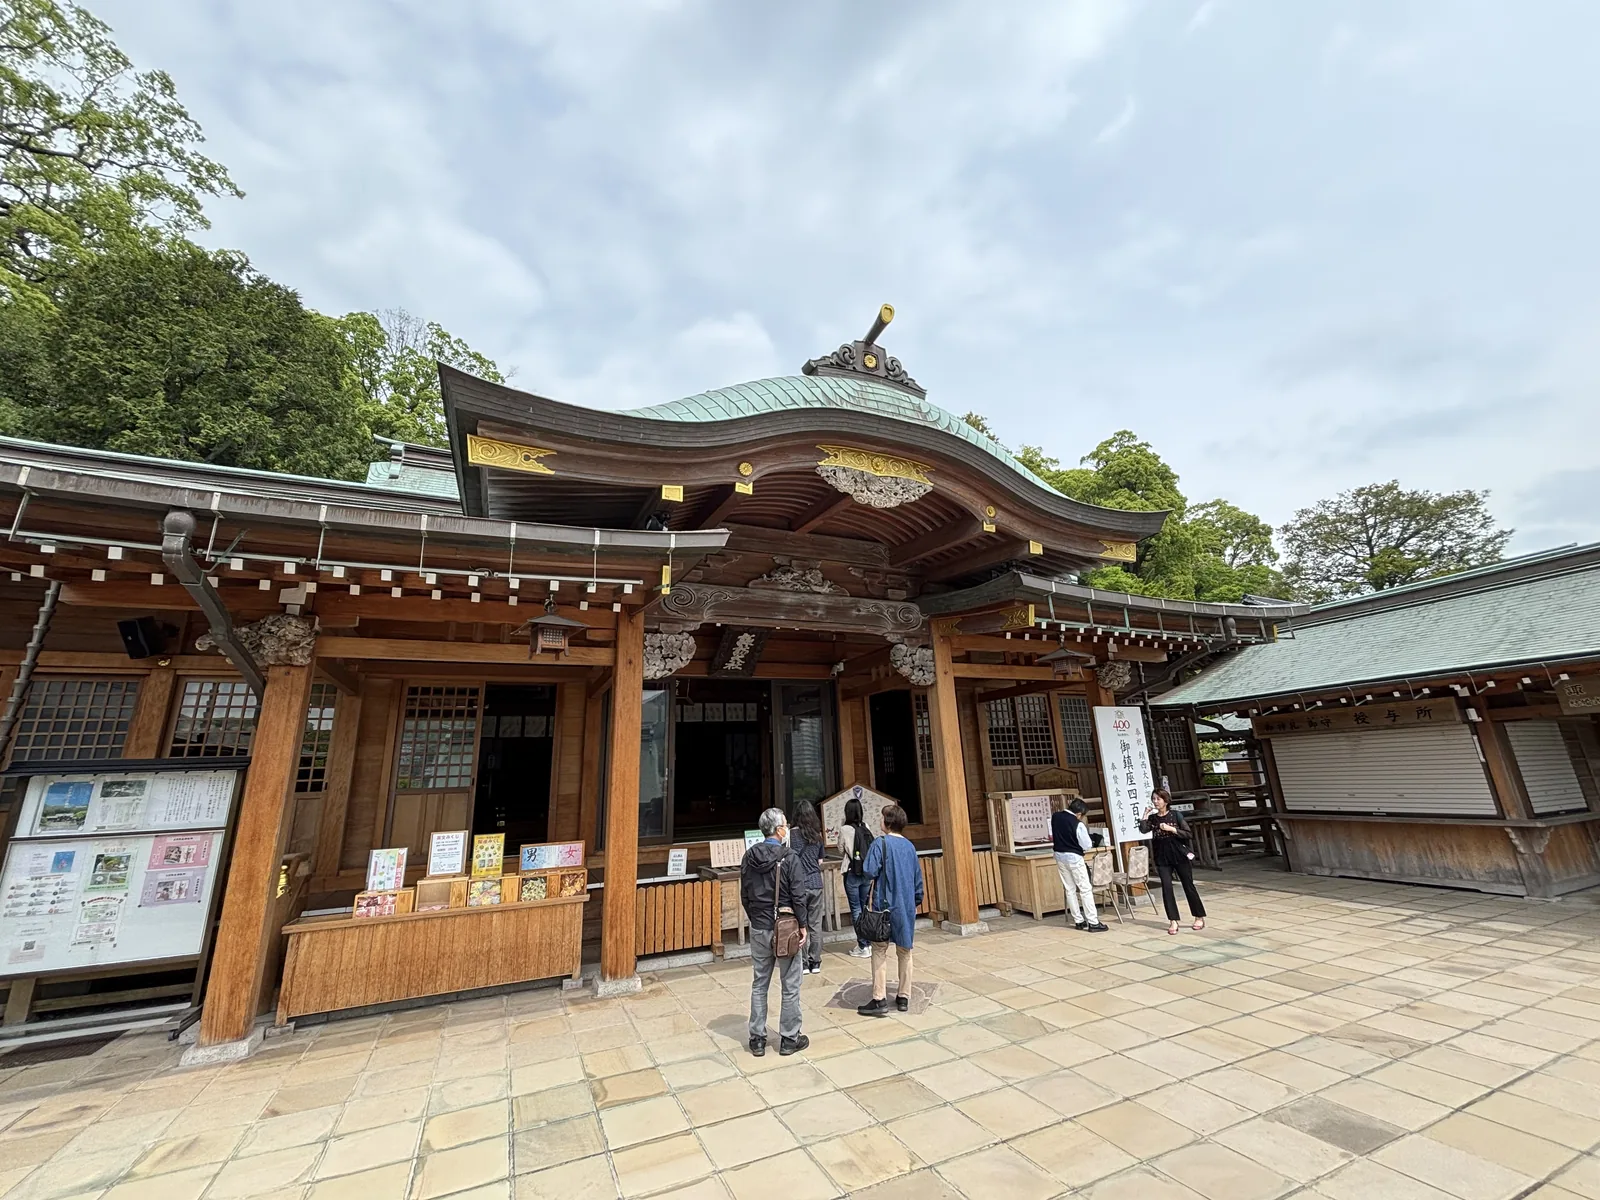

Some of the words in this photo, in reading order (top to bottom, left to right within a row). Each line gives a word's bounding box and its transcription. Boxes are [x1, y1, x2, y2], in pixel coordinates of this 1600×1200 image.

[1353, 706, 1433, 724] 授与所
[1113, 720, 1130, 731] 400
[1119, 739, 1142, 829] 御鎮座四百年
[1110, 761, 1127, 836] 奉賛金受付中
[526, 847, 538, 862] 男
[565, 845, 578, 858] 女
